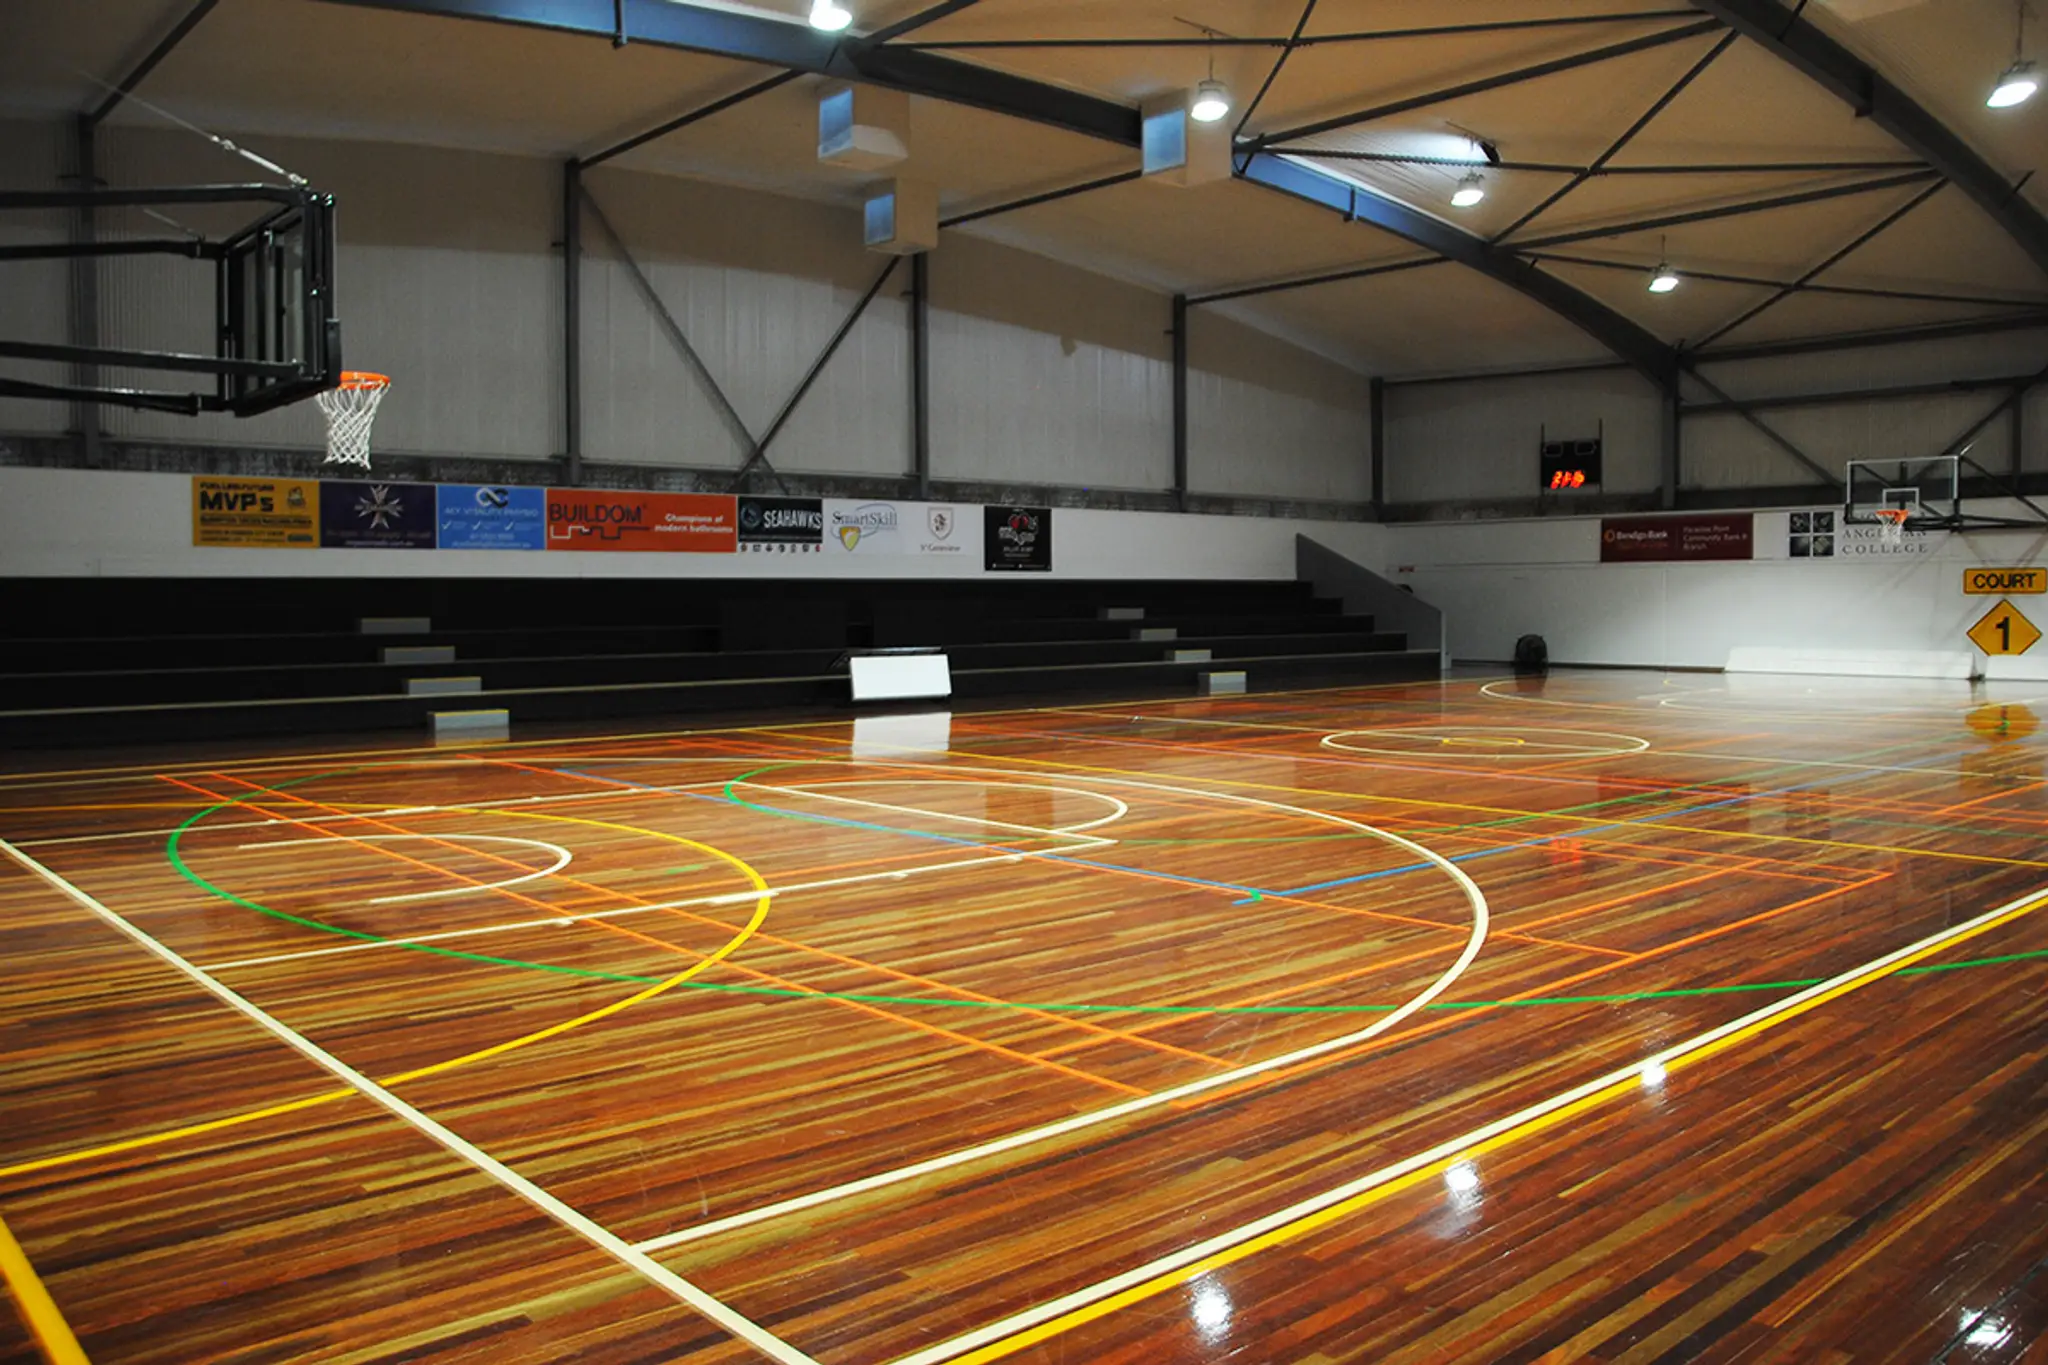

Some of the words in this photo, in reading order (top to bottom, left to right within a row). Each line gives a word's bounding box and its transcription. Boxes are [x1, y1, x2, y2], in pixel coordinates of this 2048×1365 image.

[549, 503, 643, 523] BUILDOM
[664, 513, 712, 523] Champions
[763, 509, 822, 530] SEAHAWKS
[832, 510, 897, 526] SmartSkill
[654, 524, 687, 532] modern
[689, 524, 733, 533] bathrooms
[1842, 543, 1928, 554] COLLEGE
[1973, 573, 2037, 588] COURT
[1995, 616, 2009, 651] 1
